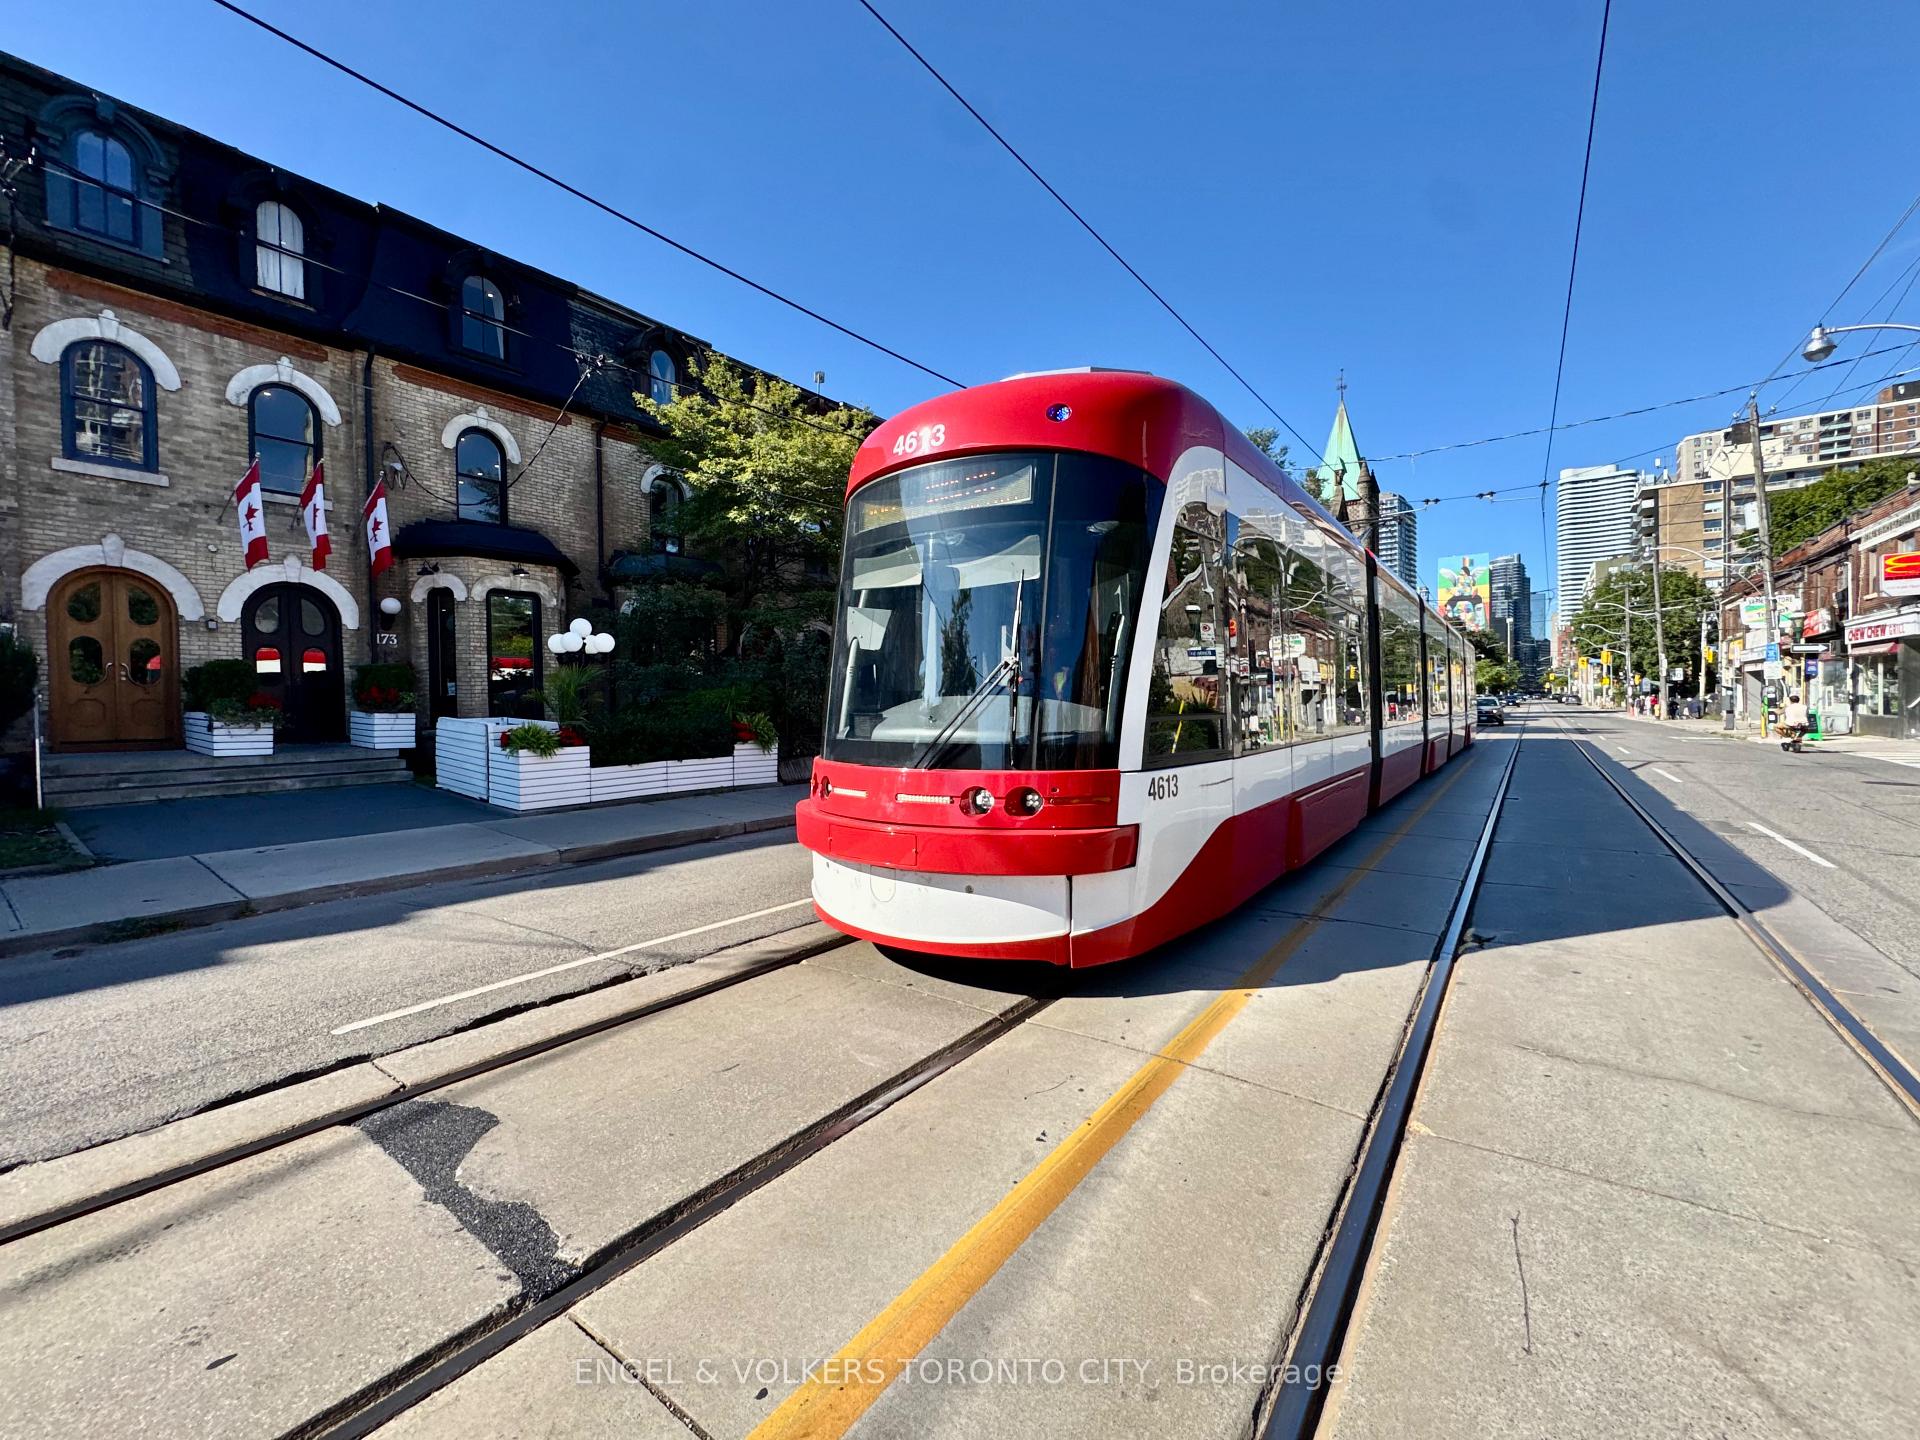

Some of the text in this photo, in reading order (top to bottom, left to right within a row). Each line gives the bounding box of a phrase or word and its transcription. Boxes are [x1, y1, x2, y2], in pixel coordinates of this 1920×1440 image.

[892, 423, 946, 456] 4613
[376, 633, 398, 645] 173
[1848, 623, 1905, 641] CHEW CHEW GRILL
[1147, 774, 1179, 801] 4613
